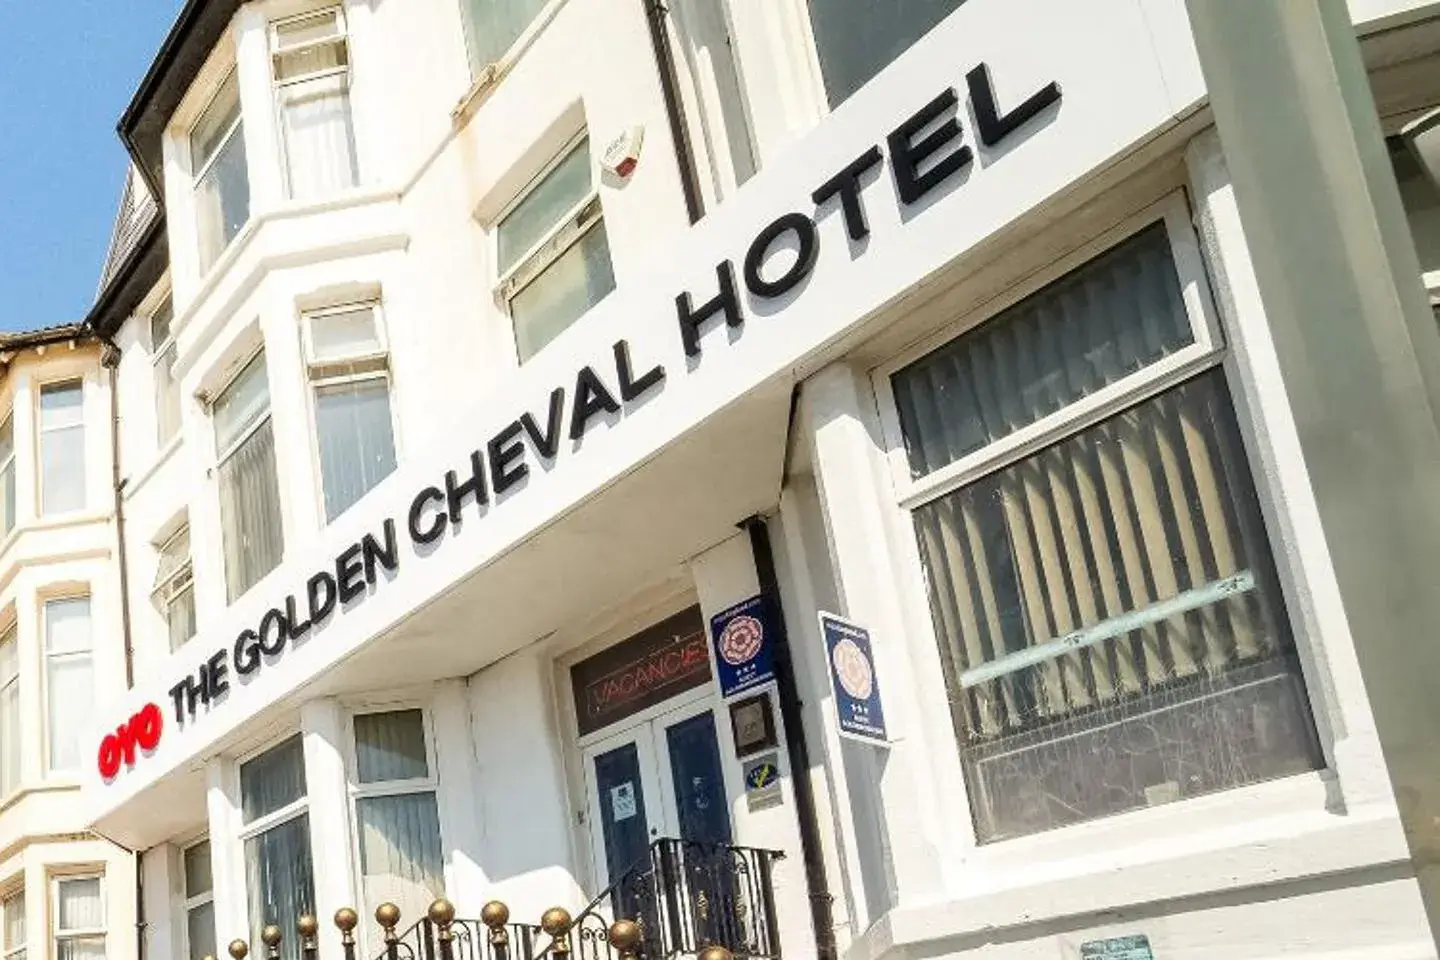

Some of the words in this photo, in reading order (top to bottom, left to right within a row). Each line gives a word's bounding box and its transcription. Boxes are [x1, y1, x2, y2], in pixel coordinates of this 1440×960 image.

[98, 703, 163, 778] OYO
[168, 648, 229, 723] THE
[234, 518, 398, 675] GOLDEN
[408, 339, 665, 544] CHEVAL
[676, 62, 1062, 357] HOTEL
